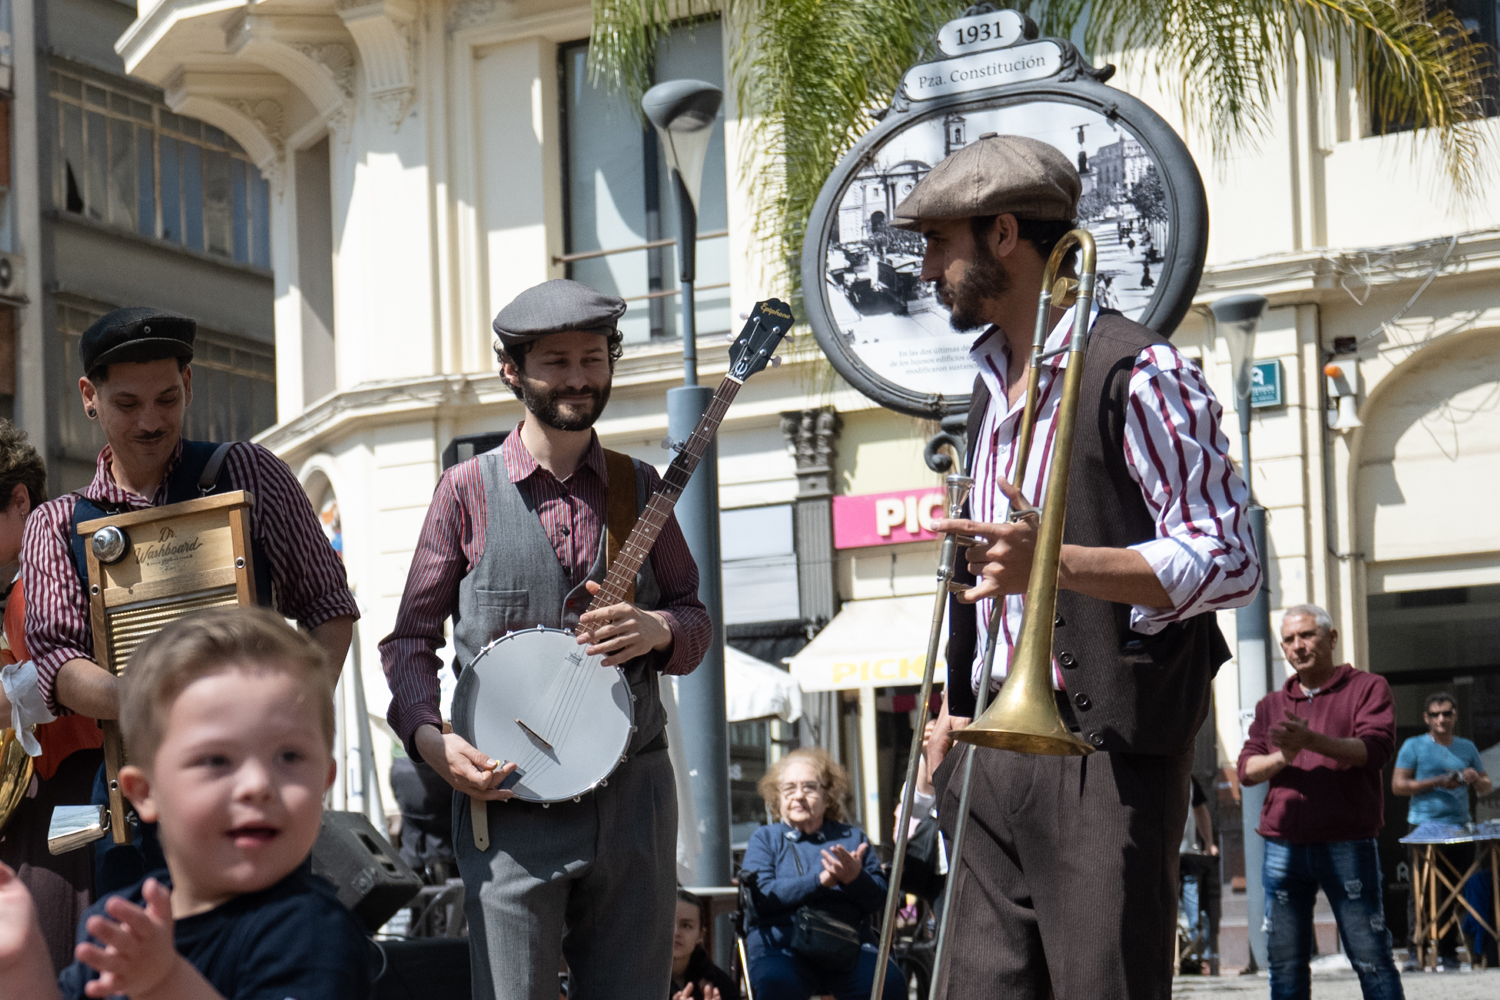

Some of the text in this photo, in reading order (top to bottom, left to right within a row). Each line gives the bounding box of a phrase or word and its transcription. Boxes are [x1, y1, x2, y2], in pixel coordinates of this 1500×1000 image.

[956, 21, 1003, 46] 1931
[919, 55, 1046, 89] Pza. Constitución
[760, 302, 791, 320] Epiphone
[158, 526, 178, 543] Dr.
[134, 537, 203, 565] Washboard
